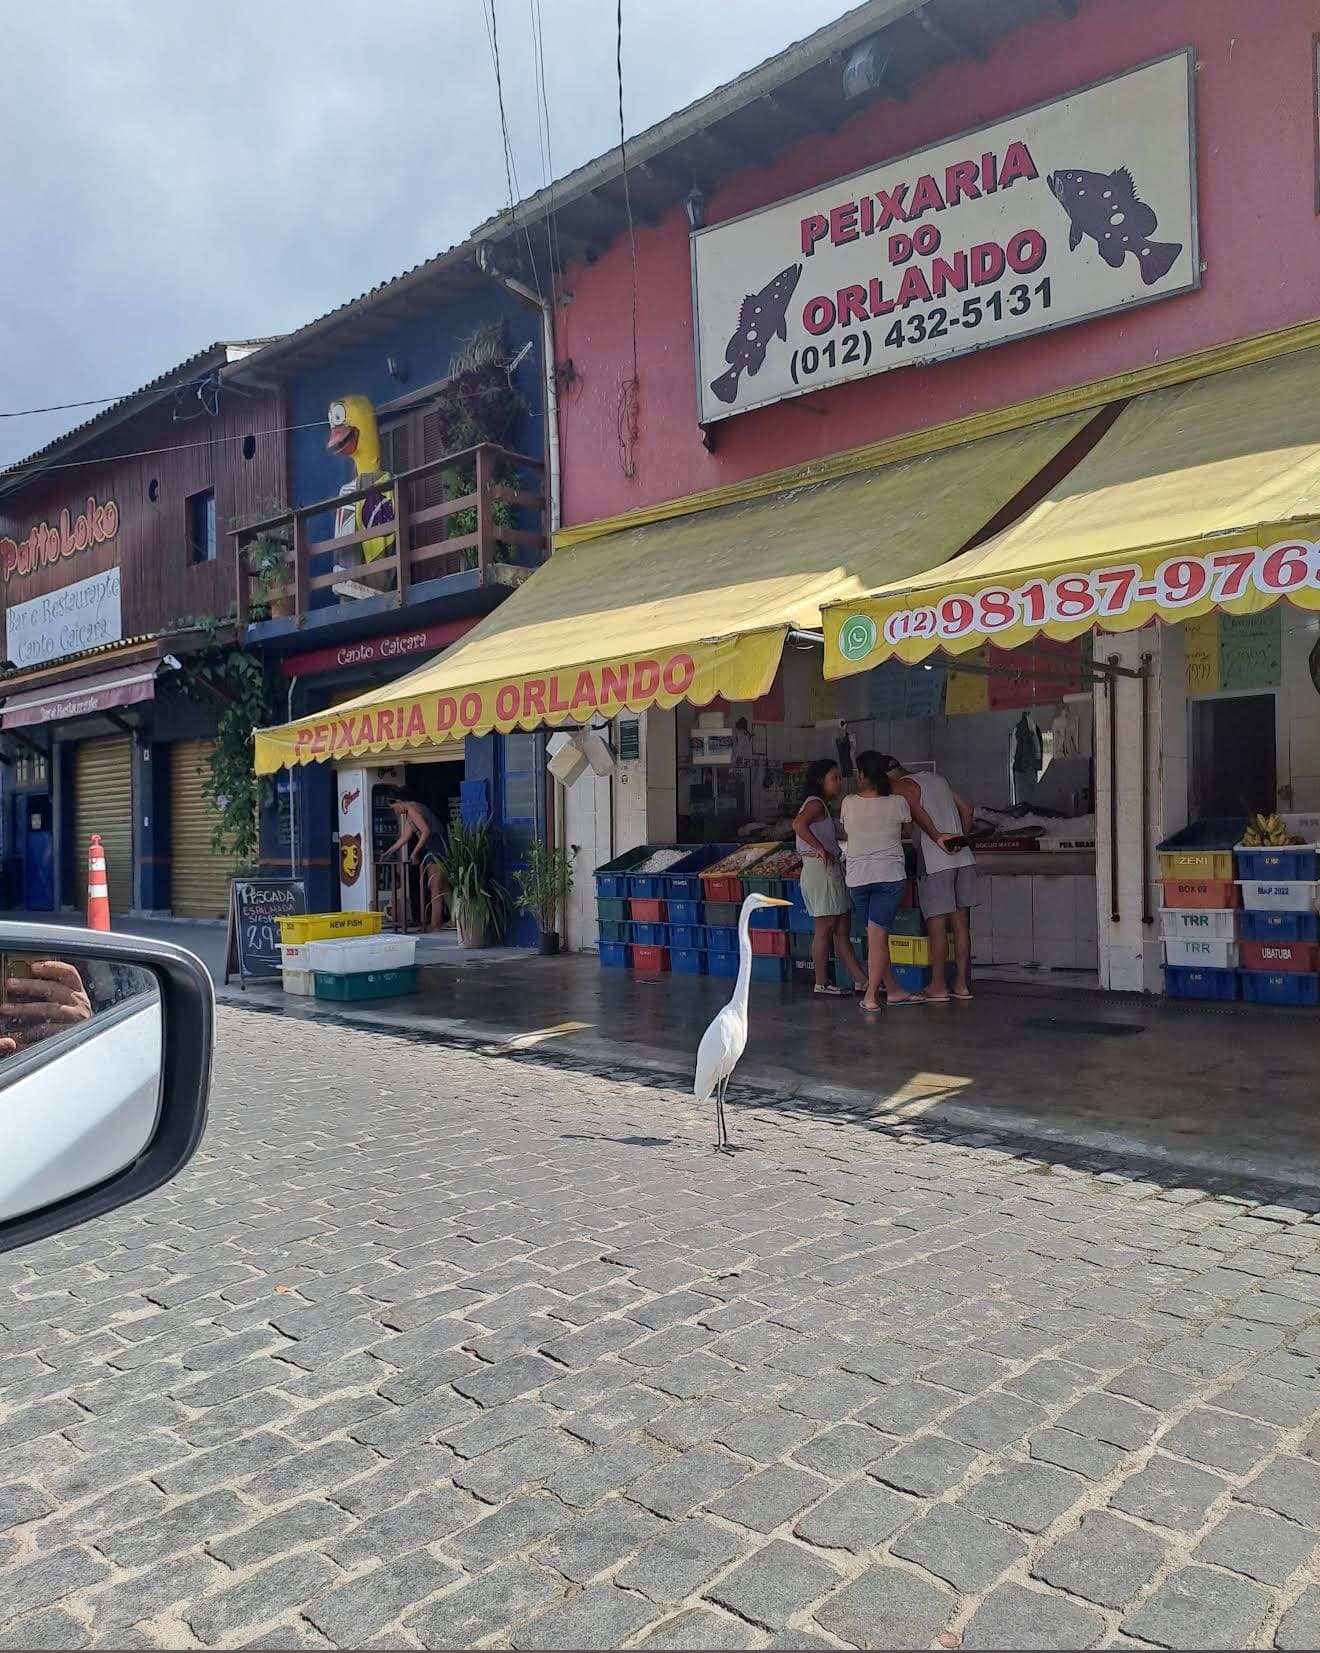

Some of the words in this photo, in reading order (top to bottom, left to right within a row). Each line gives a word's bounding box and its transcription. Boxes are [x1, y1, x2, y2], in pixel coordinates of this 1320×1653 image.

[801, 140, 1039, 256] PEIXARIA
[888, 223, 941, 264] DO
[801, 228, 1047, 336] ORLANDO
[790, 329, 873, 384] (012)
[884, 277, 1053, 350] 432-5131
[9, 608, 29, 633] Bar
[18, 634, 54, 663] Canto
[337, 643, 374, 666] Canto
[380, 632, 427, 657] Caiçara
[294, 706, 426, 756] PEIXARIA
[437, 691, 483, 732] DO
[495, 654, 697, 721] ORLANDO
[1179, 857, 1207, 865] ZENI
[241, 885, 295, 904] PESCADA
[330, 919, 346, 929] NEW
[347, 918, 363, 928] FISH
[1181, 915, 1209, 926] TRR
[1184, 942, 1210, 954] TRR
[1262, 948, 1292, 960] UBATUBA
